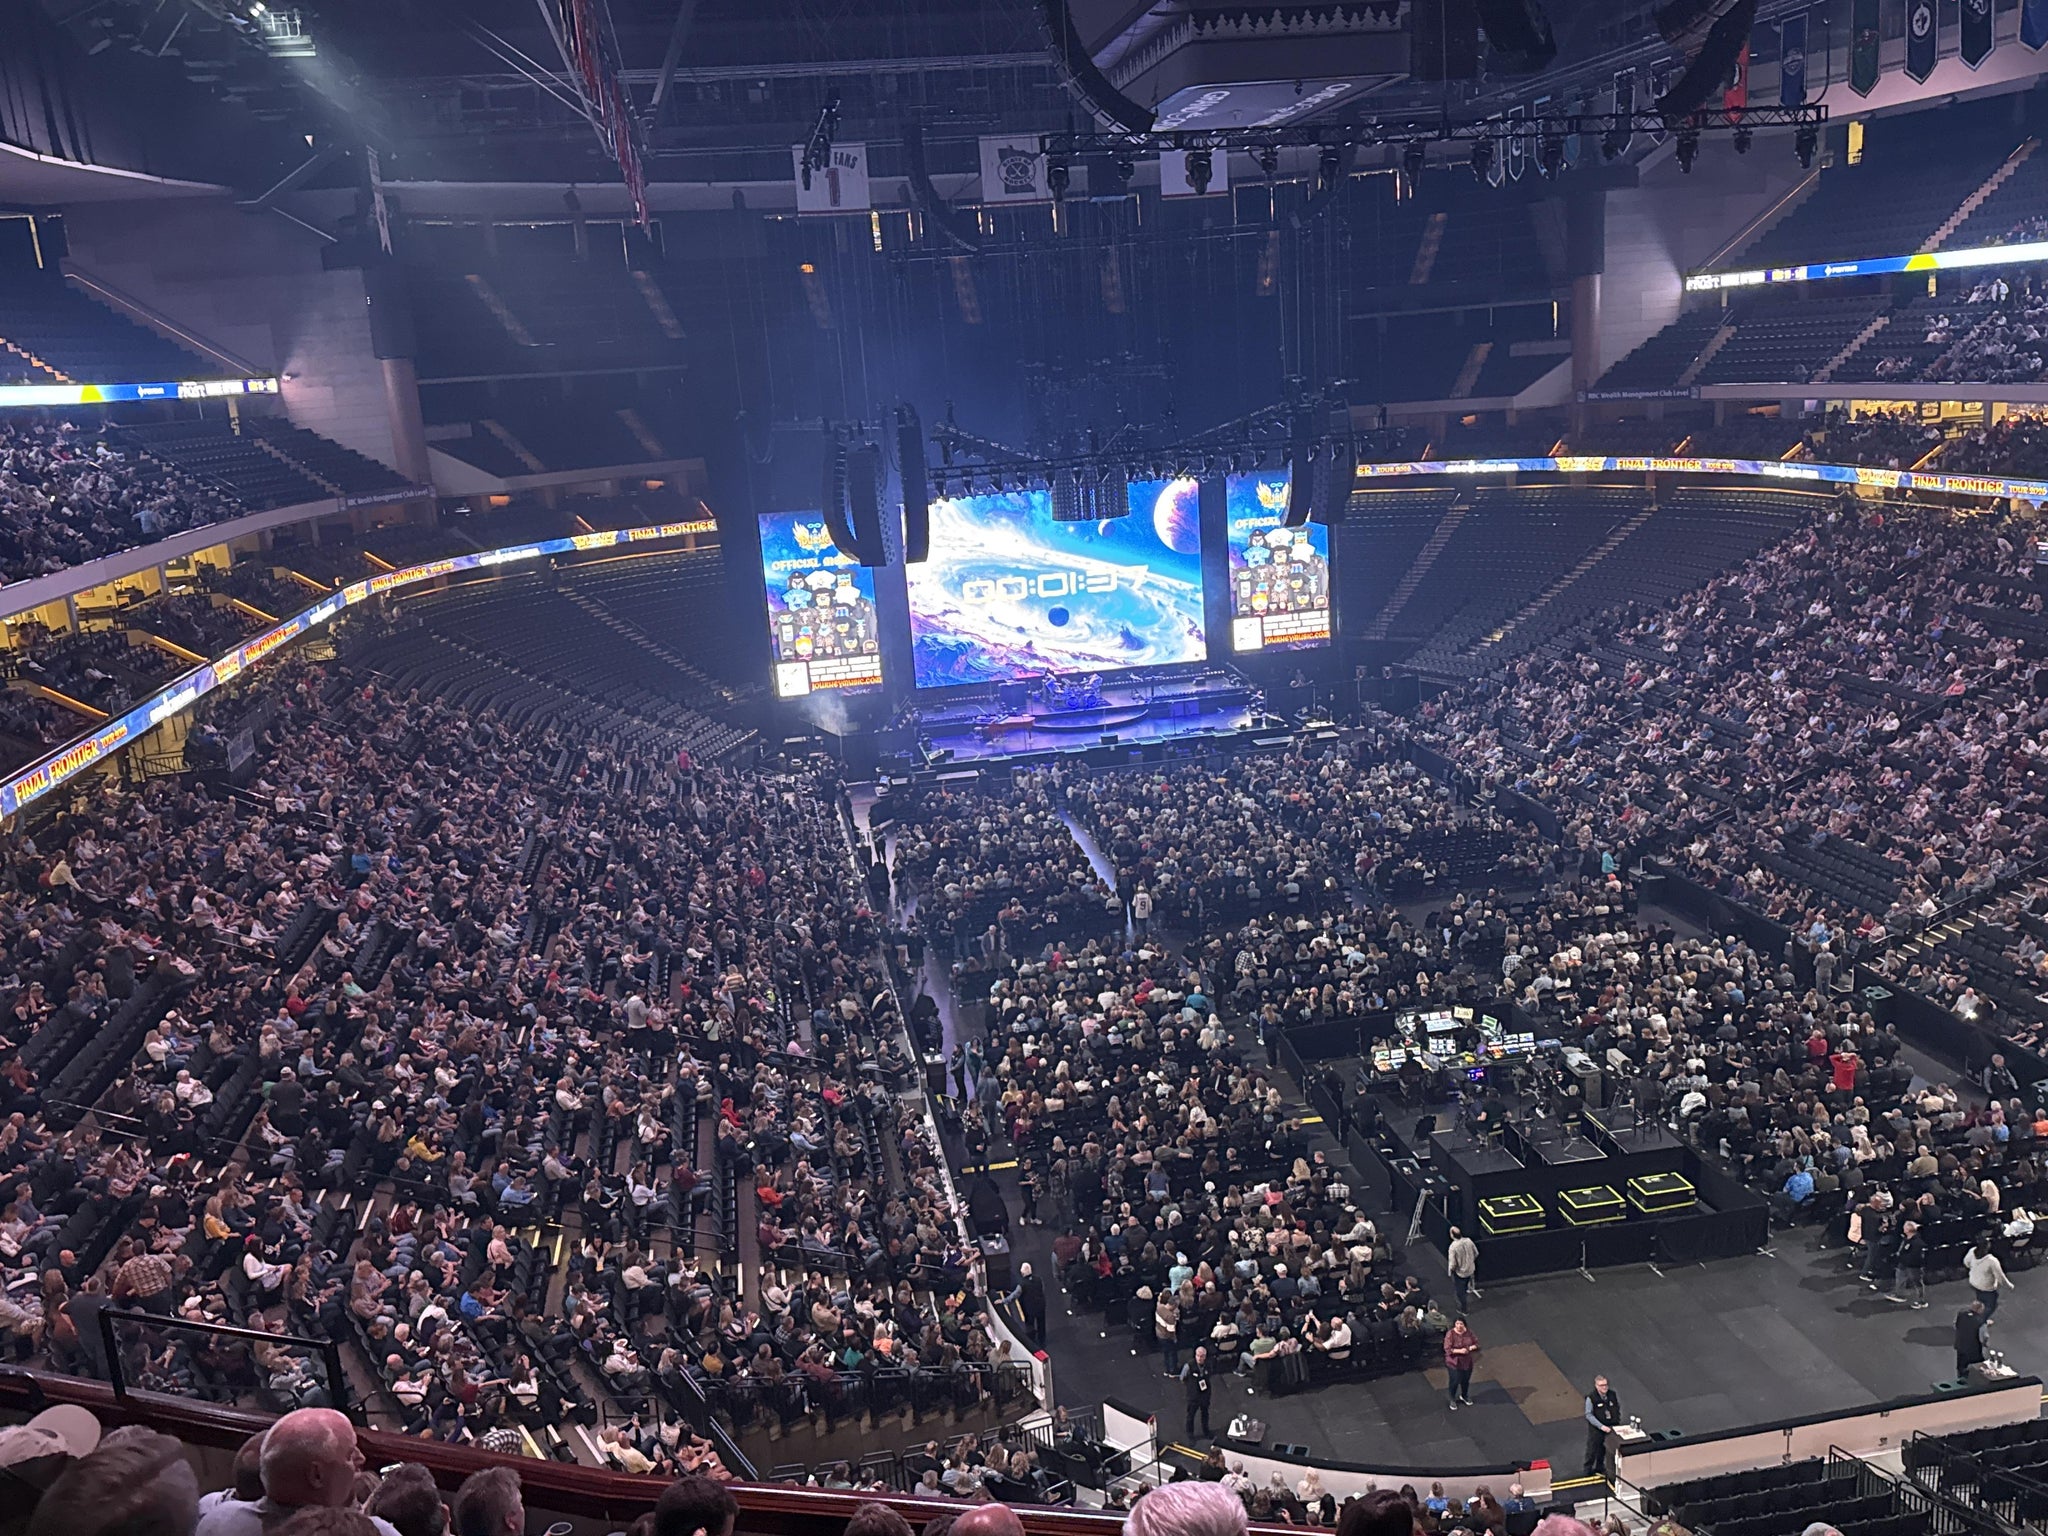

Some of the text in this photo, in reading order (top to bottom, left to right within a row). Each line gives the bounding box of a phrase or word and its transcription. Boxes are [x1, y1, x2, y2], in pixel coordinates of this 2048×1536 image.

[834, 151, 858, 170] FANS
[825, 167, 841, 207] 1
[1622, 391, 1659, 400] Management
[1674, 389, 1689, 397] Level
[1616, 459, 1649, 471] FINAL
[1651, 459, 1702, 471] FRONTIER
[1911, 476, 1944, 488] FINAL
[1944, 478, 2005, 494] FRONTIER
[2008, 485, 2029, 495] TOUR
[2029, 486, 2048, 496] 2026
[628, 527, 660, 541] FINAL
[661, 519, 716, 537] FRONTIER
[391, 567, 429, 586] FRONTIER
[13, 771, 50, 807] FINAL
[48, 738, 101, 780] FRONTIER
